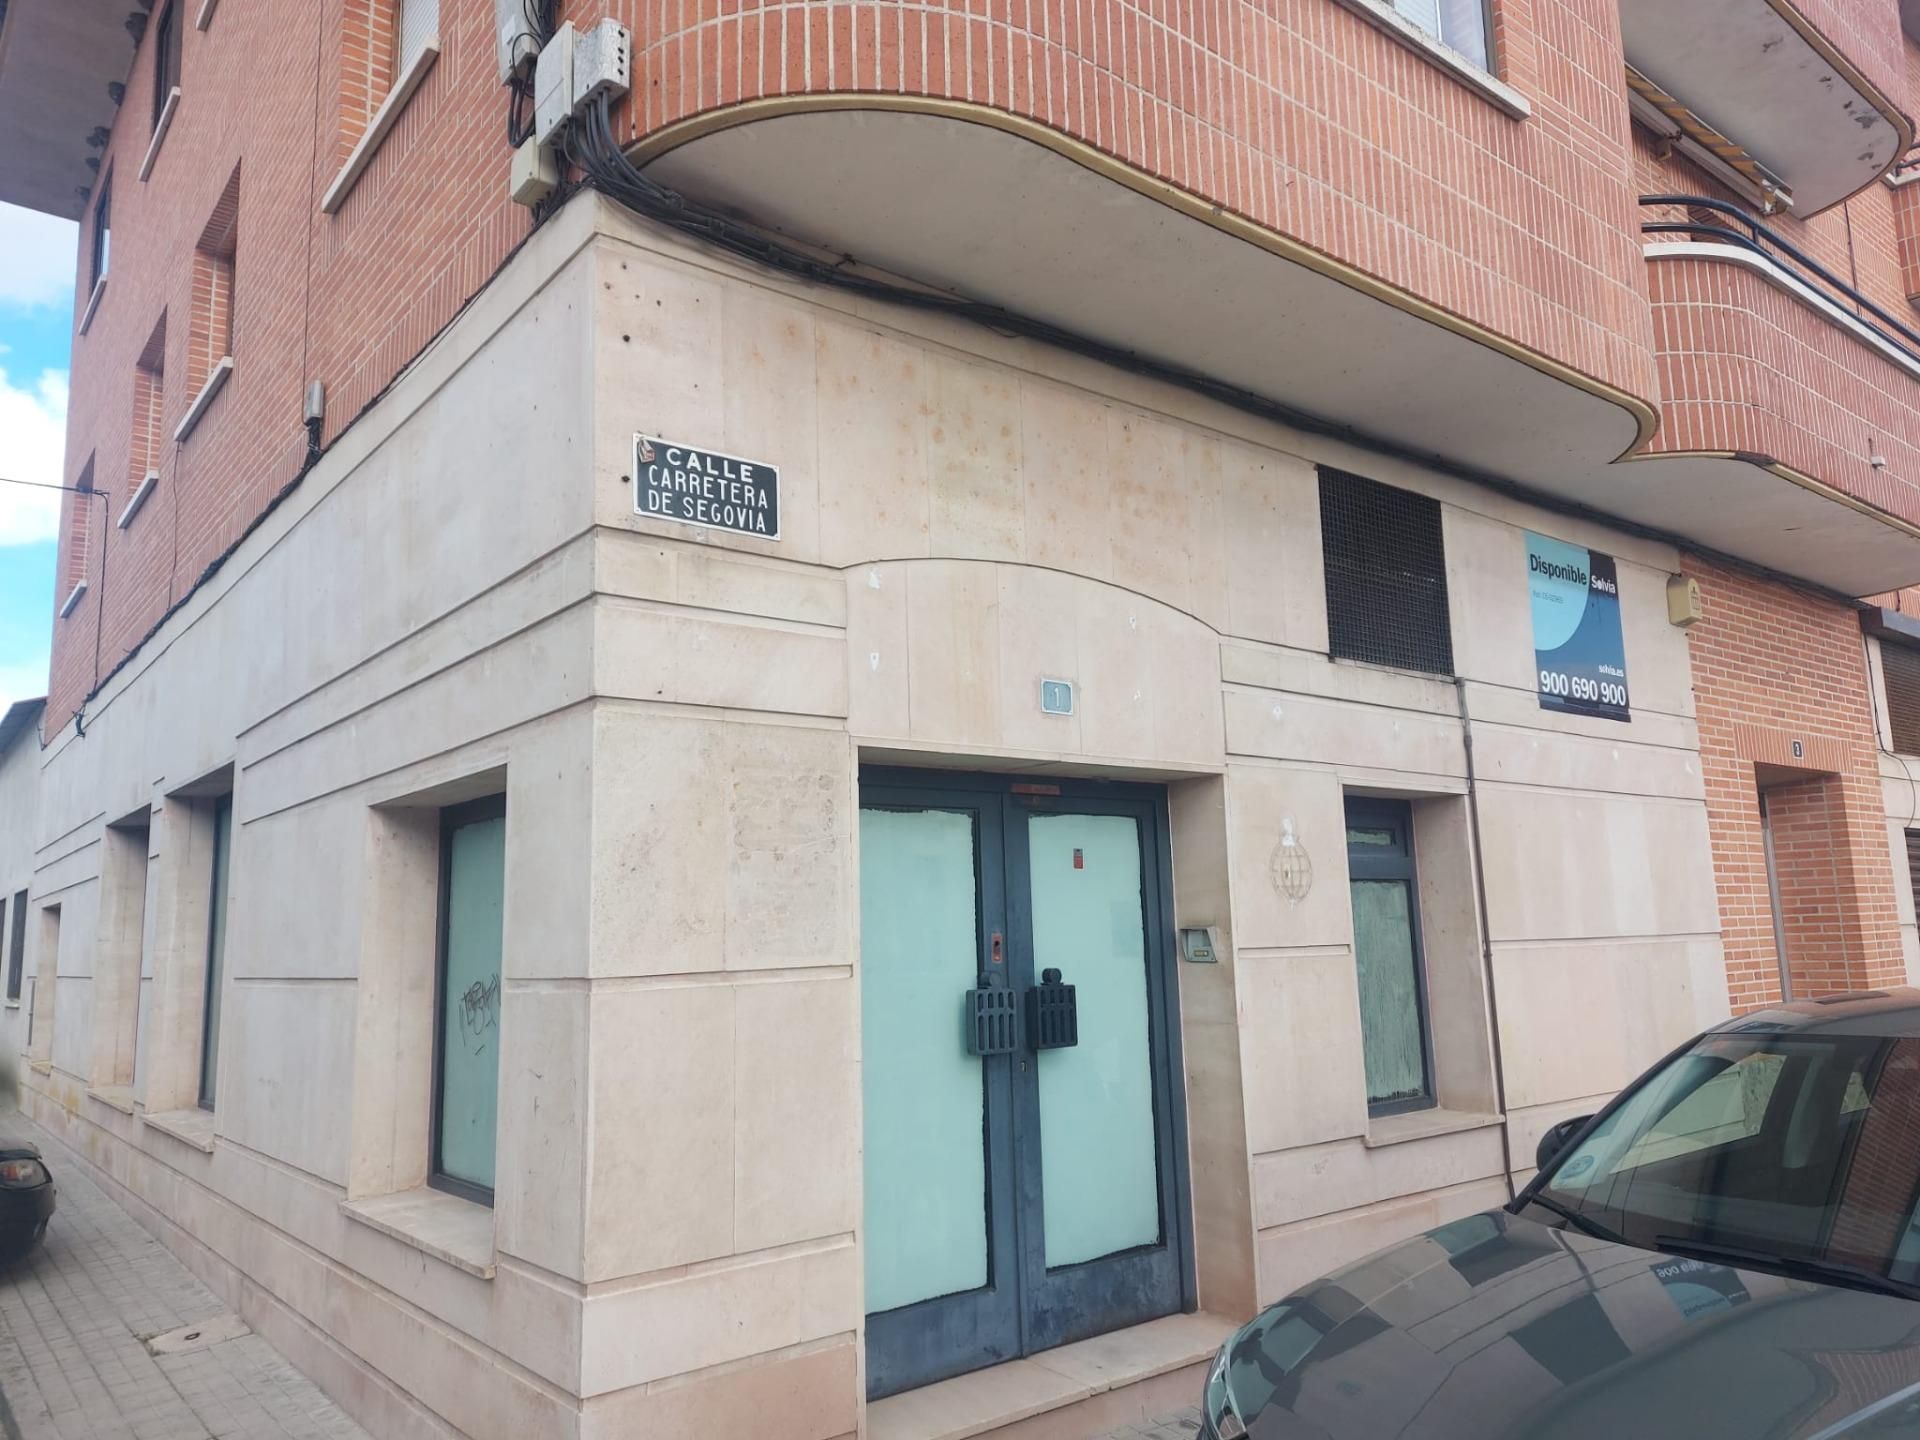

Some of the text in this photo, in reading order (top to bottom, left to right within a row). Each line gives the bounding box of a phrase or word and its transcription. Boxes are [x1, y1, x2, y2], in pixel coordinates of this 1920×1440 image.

[666, 449, 753, 483] CALLE
[649, 465, 768, 509] CARRETERA
[648, 490, 766, 532] DE SEGOVIA
[1530, 553, 1587, 586] Disponible
[1591, 575, 1616, 594] Solvia
[1054, 687, 1060, 707] 1
[1541, 670, 1626, 707] 900 690 900
